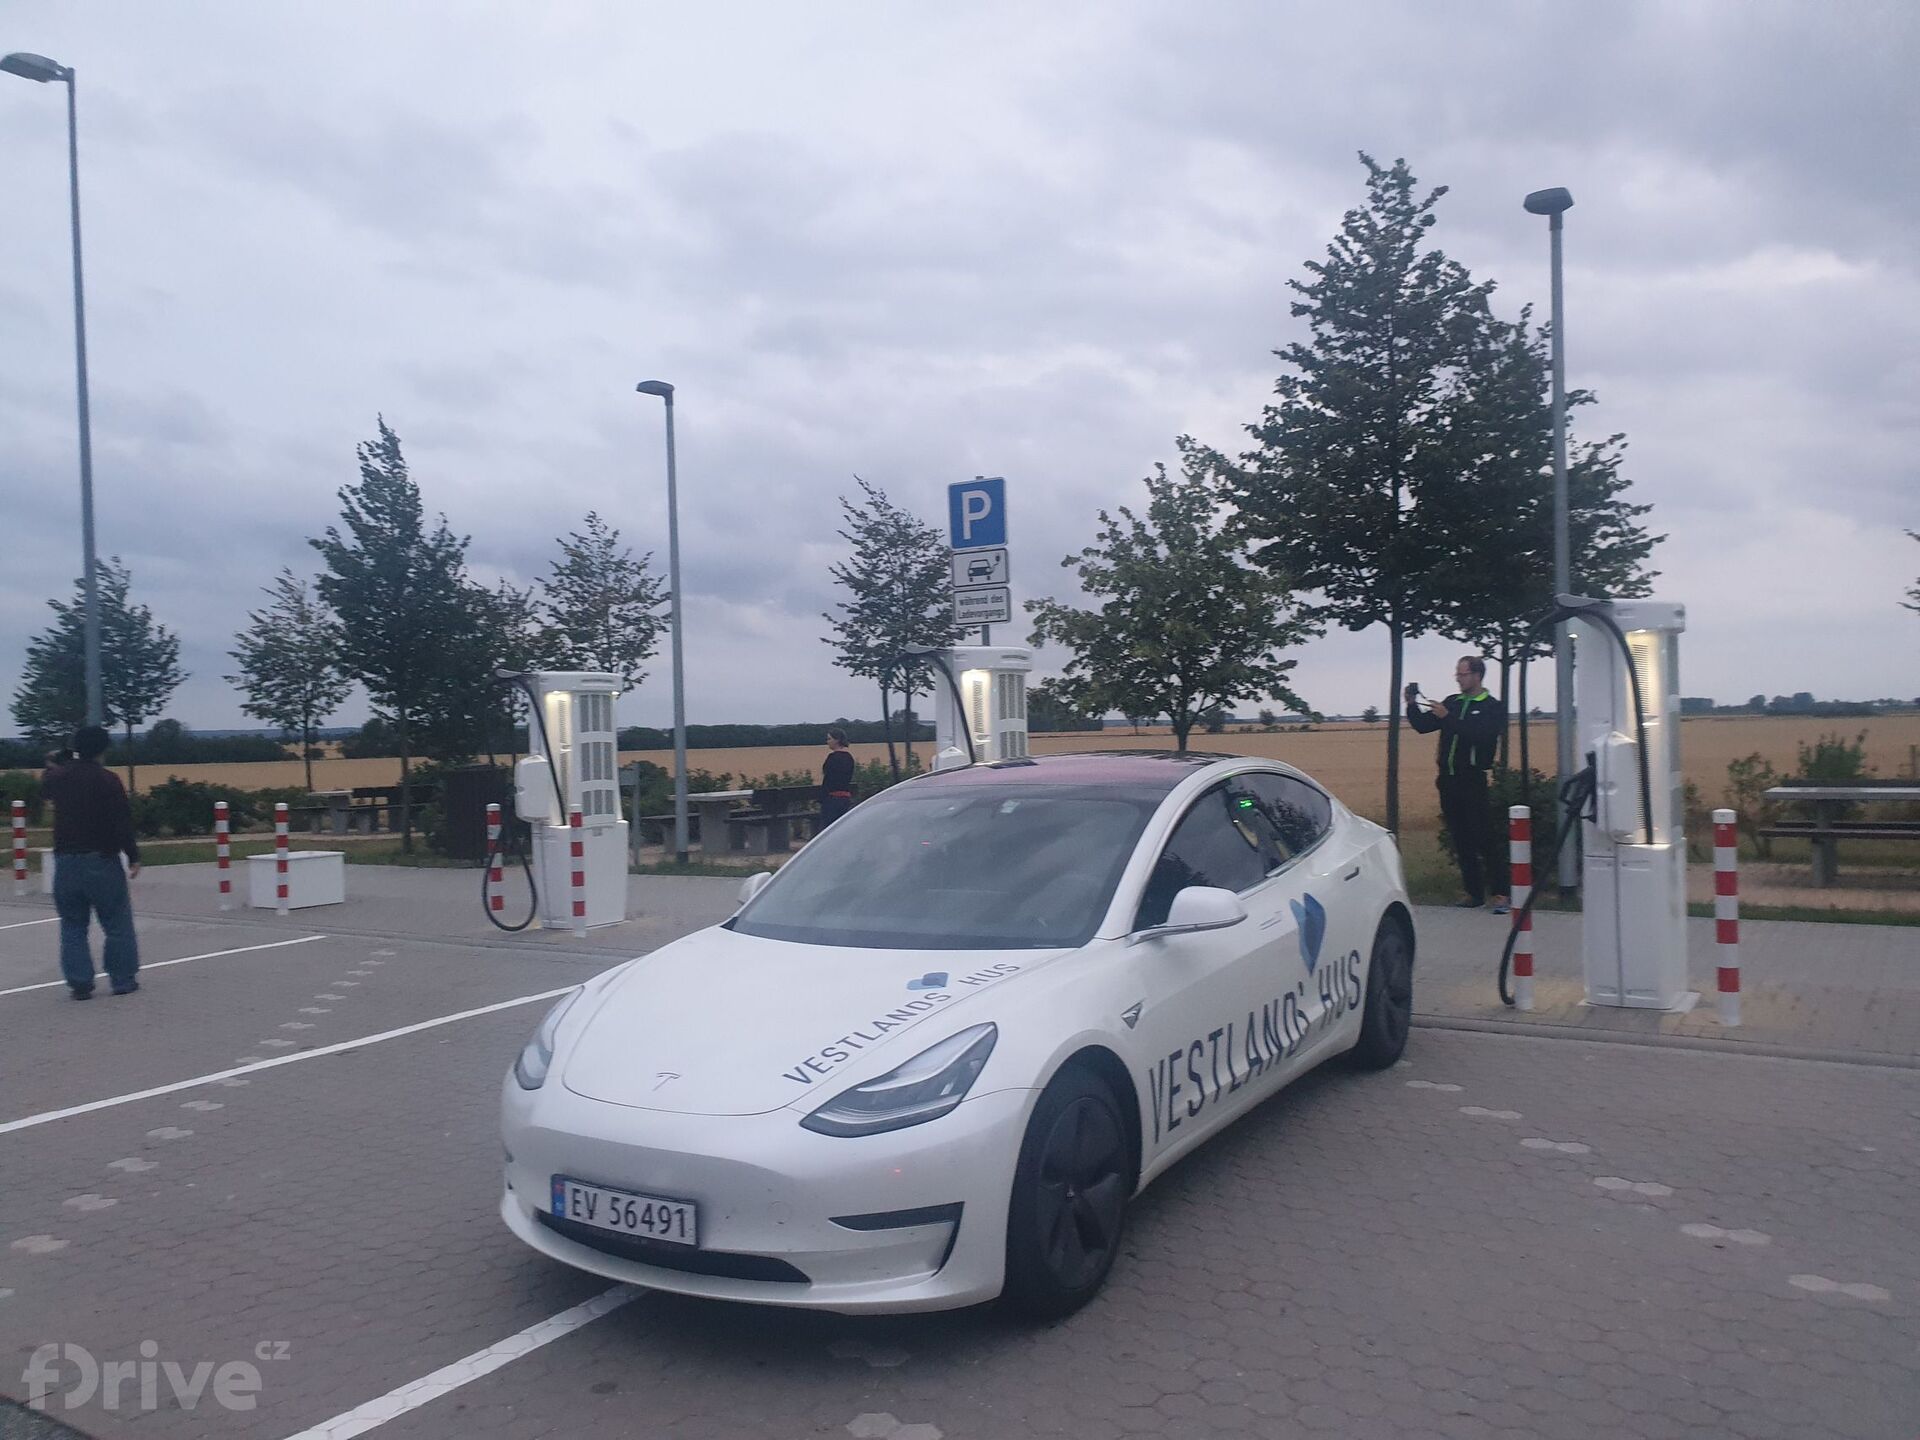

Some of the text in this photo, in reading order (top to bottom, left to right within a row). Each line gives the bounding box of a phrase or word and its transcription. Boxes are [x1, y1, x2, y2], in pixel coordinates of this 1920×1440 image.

[961, 489, 992, 540] P
[782, 963, 1021, 1085] VESTLANDS HUS
[1149, 949, 1361, 1144] VESTLANDS HUS
[572, 1188, 686, 1238] EV 56491
